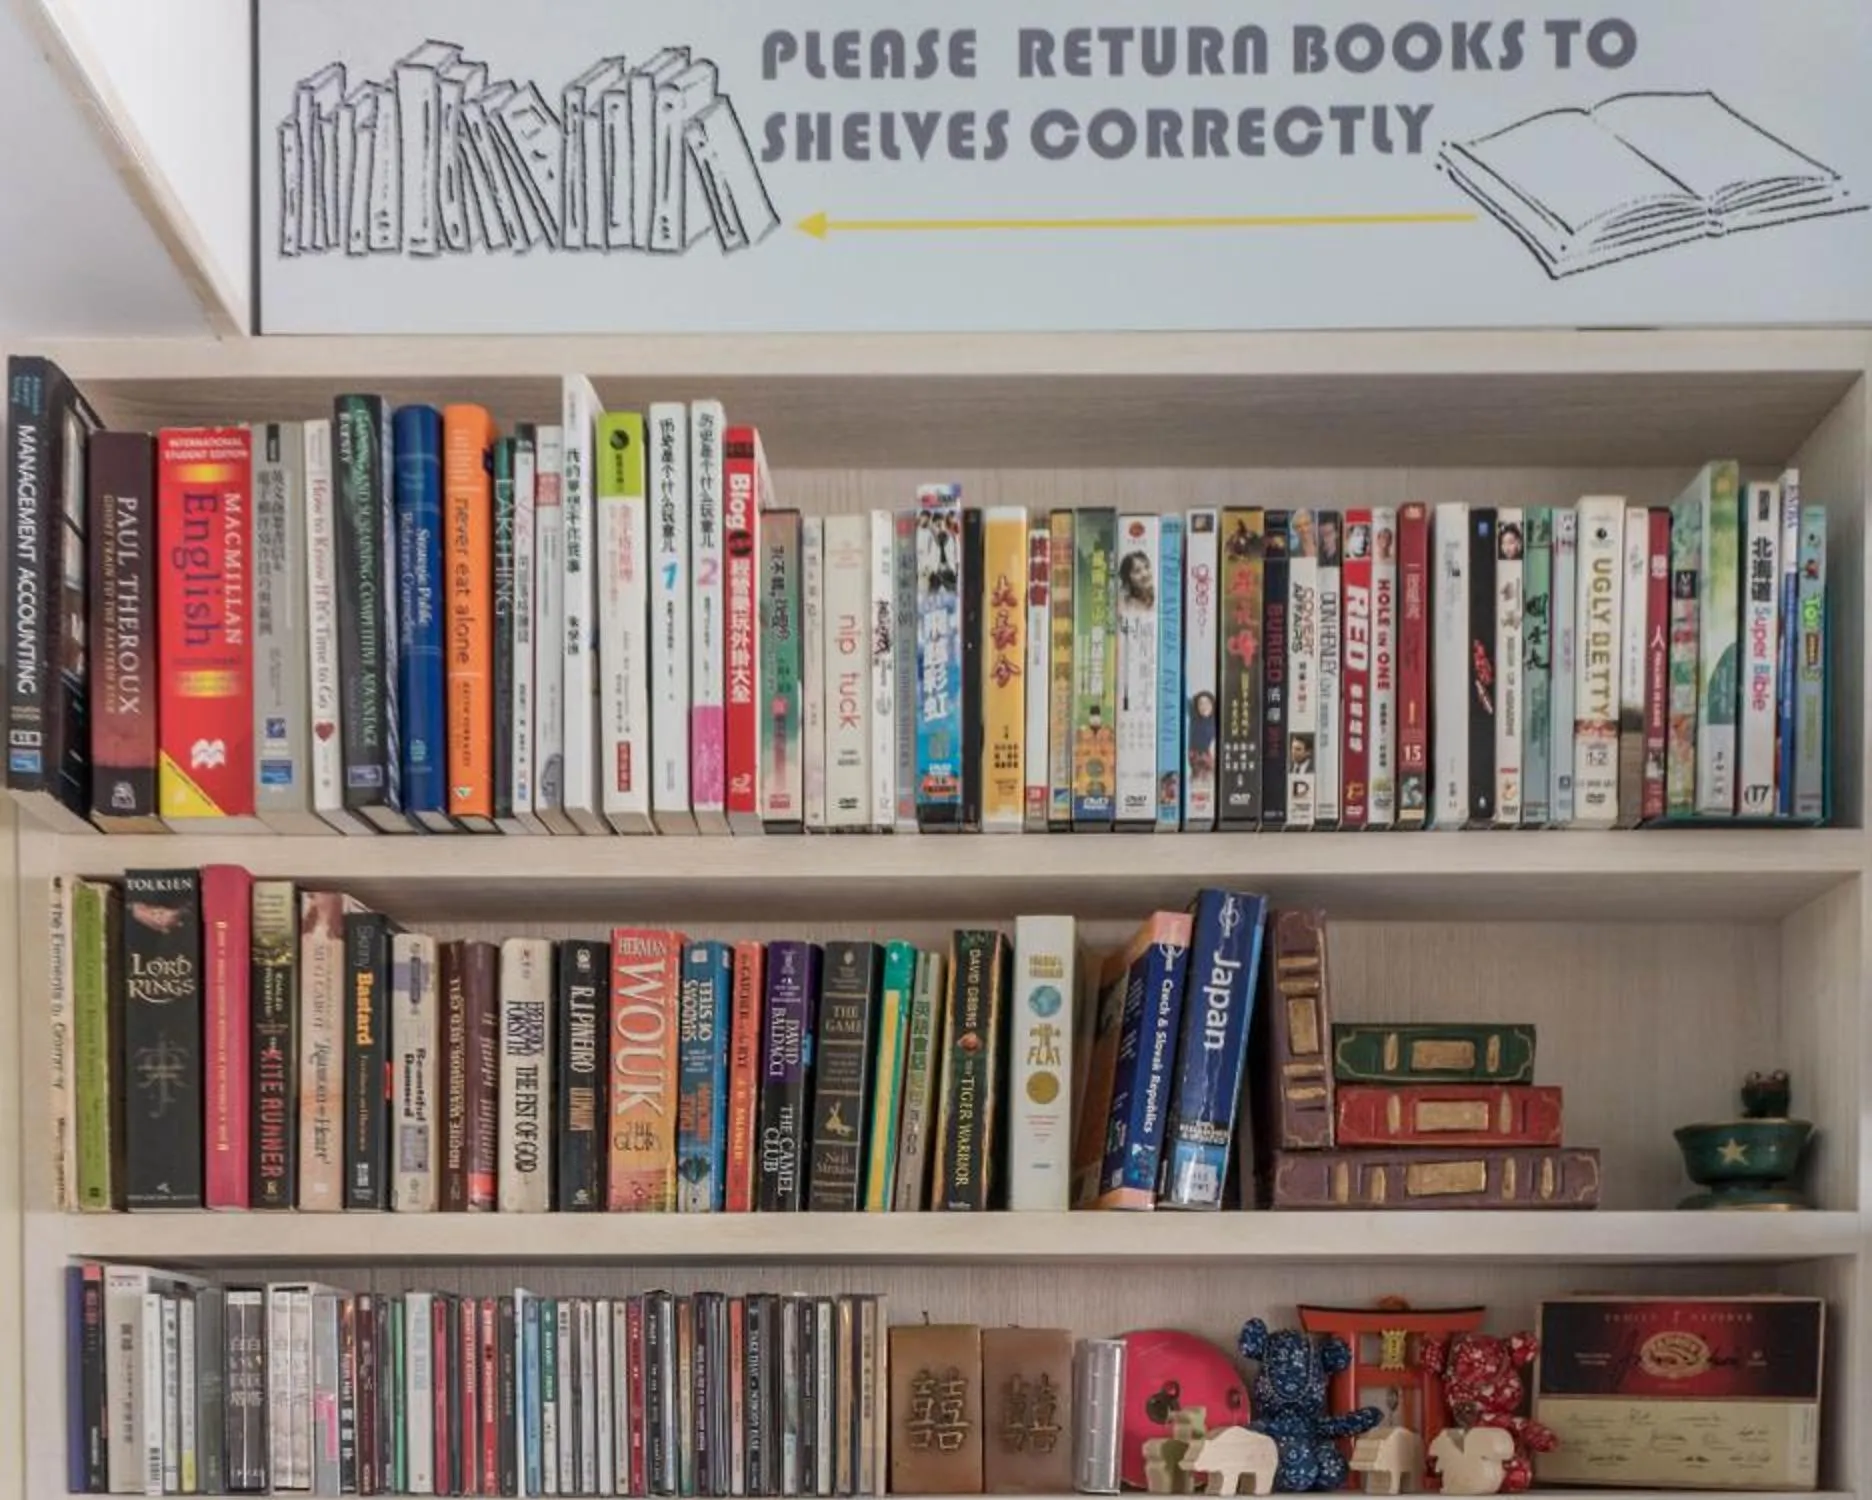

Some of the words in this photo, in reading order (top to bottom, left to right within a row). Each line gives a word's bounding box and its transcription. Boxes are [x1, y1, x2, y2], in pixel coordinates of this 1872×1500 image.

[761, 28, 978, 80] PLEASE
[1017, 25, 1270, 79] RETURN
[1293, 20, 1526, 75] BOOKS
[1544, 19, 1638, 70] TO
[761, 111, 1009, 162] SHELVES
[1029, 104, 1435, 160] CORRECTLY
[164, 449, 203, 461] STUDENT
[206, 449, 248, 460] EDITION
[168, 437, 244, 449] INTERNATIONAL
[17, 424, 38, 561] MANAGEMENT
[312, 478, 328, 513] How
[726, 472, 751, 531] Blog
[116, 496, 138, 565] PAUL
[313, 517, 327, 533] to
[453, 496, 470, 557] never
[172, 491, 222, 648] English
[224, 491, 243, 646] MACMILLAN
[314, 536, 329, 582] Know
[454, 562, 471, 596] eat
[662, 562, 680, 591] 1
[698, 557, 718, 588] 2
[1320, 591, 1337, 625] DON
[1378, 579, 1391, 627] HOLE
[1591, 557, 1613, 626] UGLY
[16, 566, 39, 695] ACCOUNTING
[455, 604, 475, 664] alone
[834, 613, 858, 655] nip
[1291, 582, 1304, 654] AFFAIRS
[1299, 585, 1315, 658] COVERT
[1345, 583, 1370, 670] RED
[1378, 633, 1388, 646] IN
[1750, 606, 1772, 660] Super
[117, 573, 140, 716] THEROUX
[316, 626, 331, 663] Time
[1267, 603, 1283, 682] BURIED
[1320, 626, 1338, 676] HENLEY
[317, 666, 331, 683] to
[1377, 652, 1391, 691] ONE
[1589, 630, 1612, 721] BETTY
[1751, 662, 1772, 712] Bible
[317, 686, 334, 709] Go
[363, 671, 379, 747] ADVANTAGE
[838, 671, 861, 729] tuck
[1404, 744, 1422, 762] 15
[126, 877, 193, 892] TOLKIEN
[51, 932, 65, 998] Elements
[131, 953, 193, 978] LORD
[618, 937, 667, 955] HERMAN
[968, 949, 982, 984] DAVID
[127, 977, 196, 1004] RINGS
[356, 971, 374, 1047] Bastard
[832, 1005, 859, 1018] THE
[1158, 978, 1175, 1016] Czech
[1203, 948, 1241, 1051] Japan
[615, 958, 667, 1116] WOUK
[769, 1007, 786, 1077] BALDACCI
[785, 1019, 800, 1065] DAVID
[825, 1019, 864, 1033] GAME
[1157, 1018, 1169, 1028] &
[260, 1048, 284, 1094] KITE
[1150, 1029, 1168, 1071] Slovak
[515, 1065, 539, 1091] THE
[958, 1075, 976, 1121] TIGER
[516, 1092, 538, 1120] FIST
[780, 1103, 794, 1133] THE
[1143, 1072, 1162, 1134] Republics
[259, 1098, 284, 1179] RUNNER
[515, 1121, 537, 1141] OF
[763, 1127, 780, 1173] CLUB
[514, 1141, 538, 1173] GOD
[777, 1137, 795, 1197] CAMEL
[954, 1123, 974, 1187] WARRIOR
